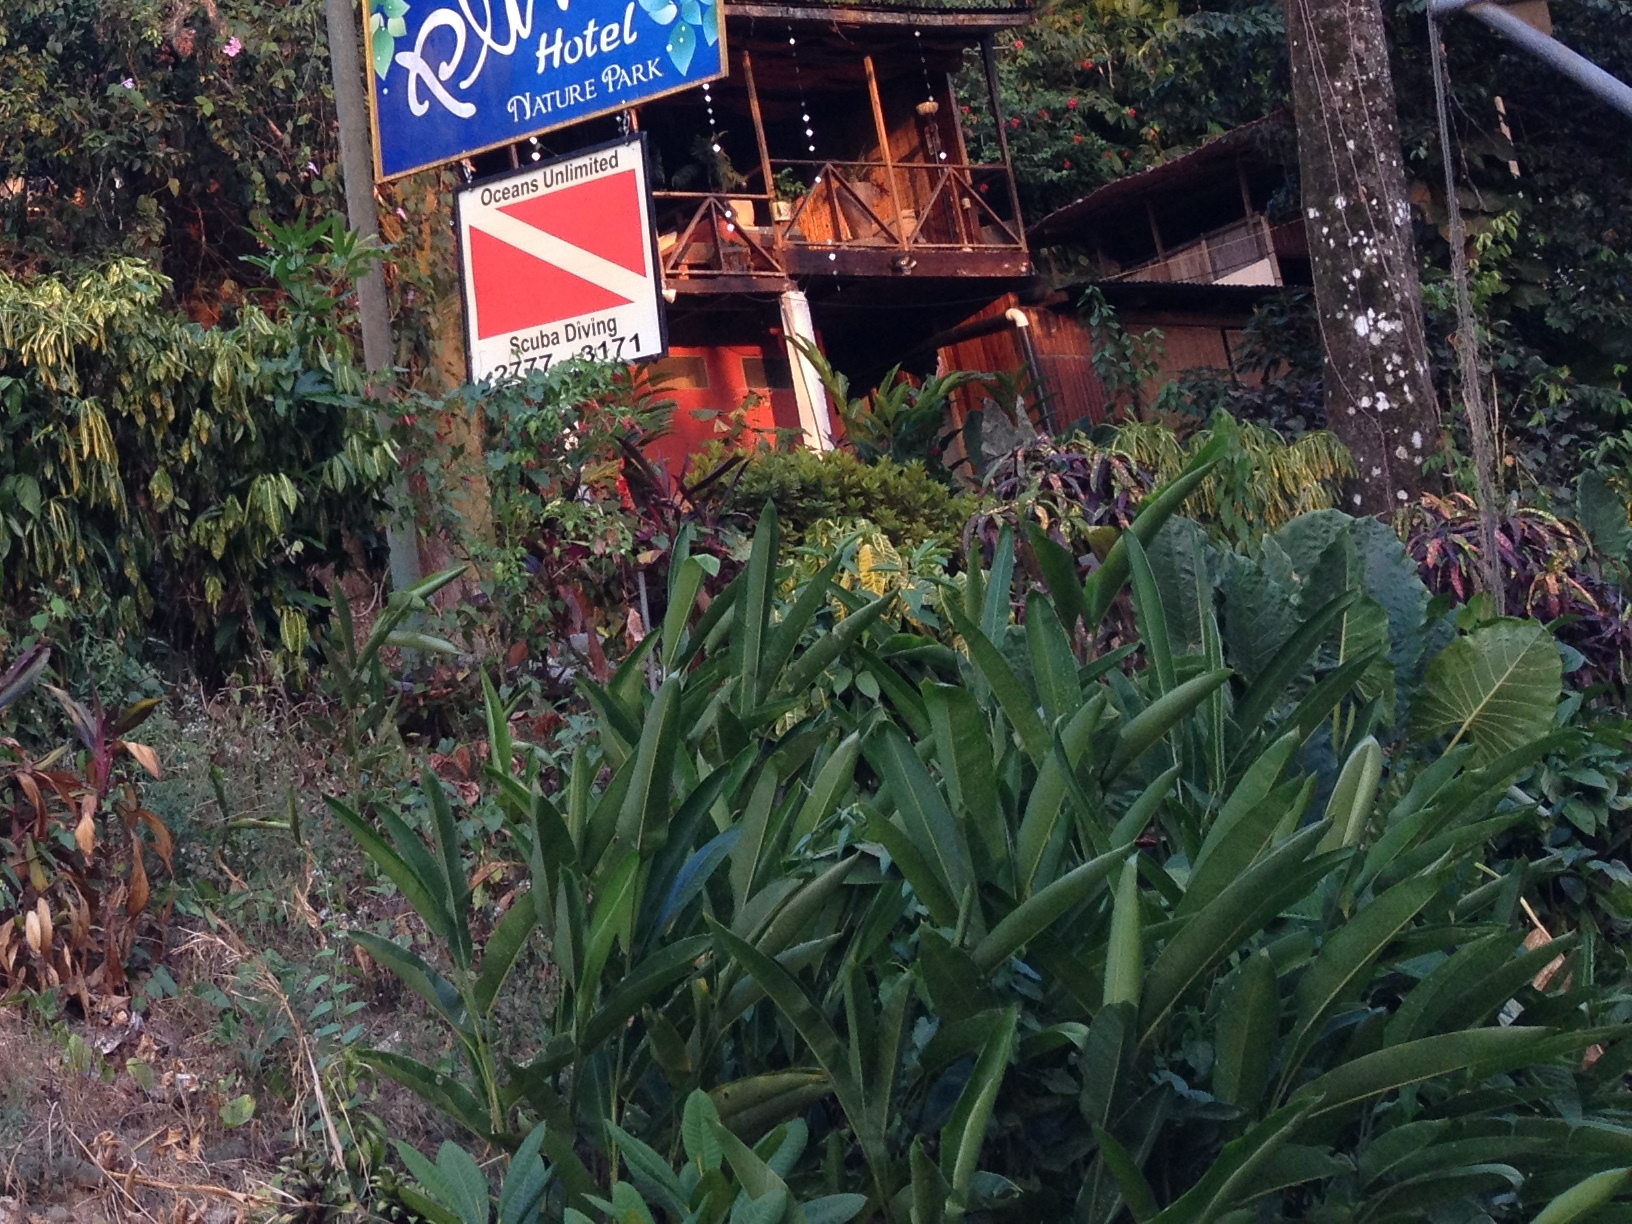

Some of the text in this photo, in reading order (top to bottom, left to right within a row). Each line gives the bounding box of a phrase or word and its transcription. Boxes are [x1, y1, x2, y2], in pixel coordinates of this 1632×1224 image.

[536, 2, 638, 75] Hotel
[507, 57, 664, 123] NATURE PARK
[480, 150, 620, 207] Oceans Unlimited
[509, 317, 618, 354] Scuba Diving
